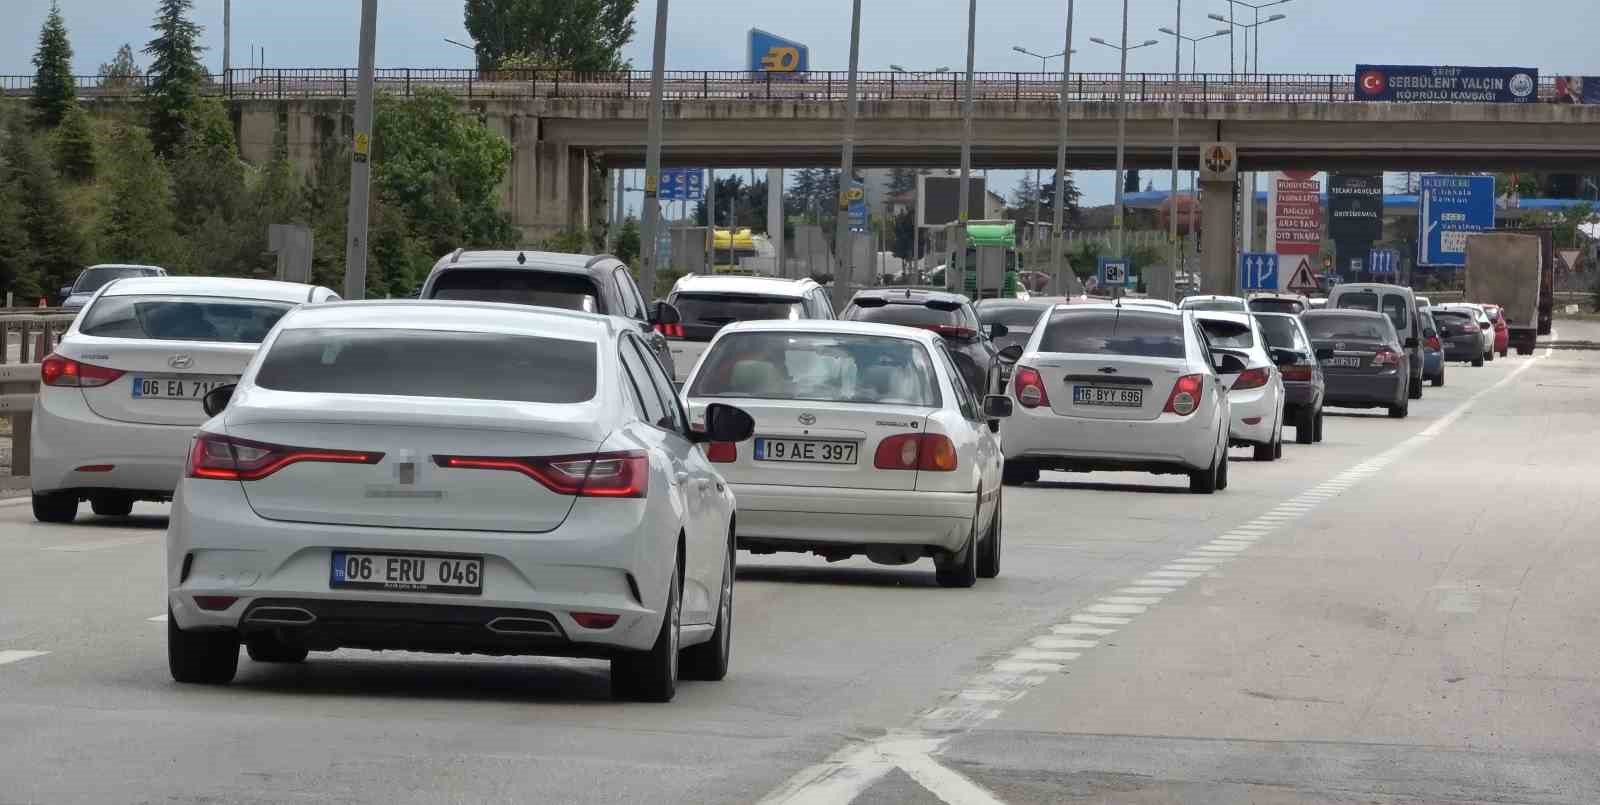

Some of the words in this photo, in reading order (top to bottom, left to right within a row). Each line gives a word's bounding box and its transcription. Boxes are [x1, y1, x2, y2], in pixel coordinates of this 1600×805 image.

[1388, 75, 1458, 90] SERBÜLENT
[1461, 77, 1504, 92] YALÇIN
[142, 380, 160, 396] 06
[167, 381, 184, 397] EA
[1080, 389, 1092, 400] 16
[1096, 389, 1116, 402] BYY
[1120, 391, 1140, 402] 696
[766, 441, 785, 459] 19
[790, 442, 816, 460] AE
[822, 445, 855, 462] 397
[346, 555, 373, 581] 06
[386, 557, 426, 583] ERU
[438, 560, 479, 585] 046
